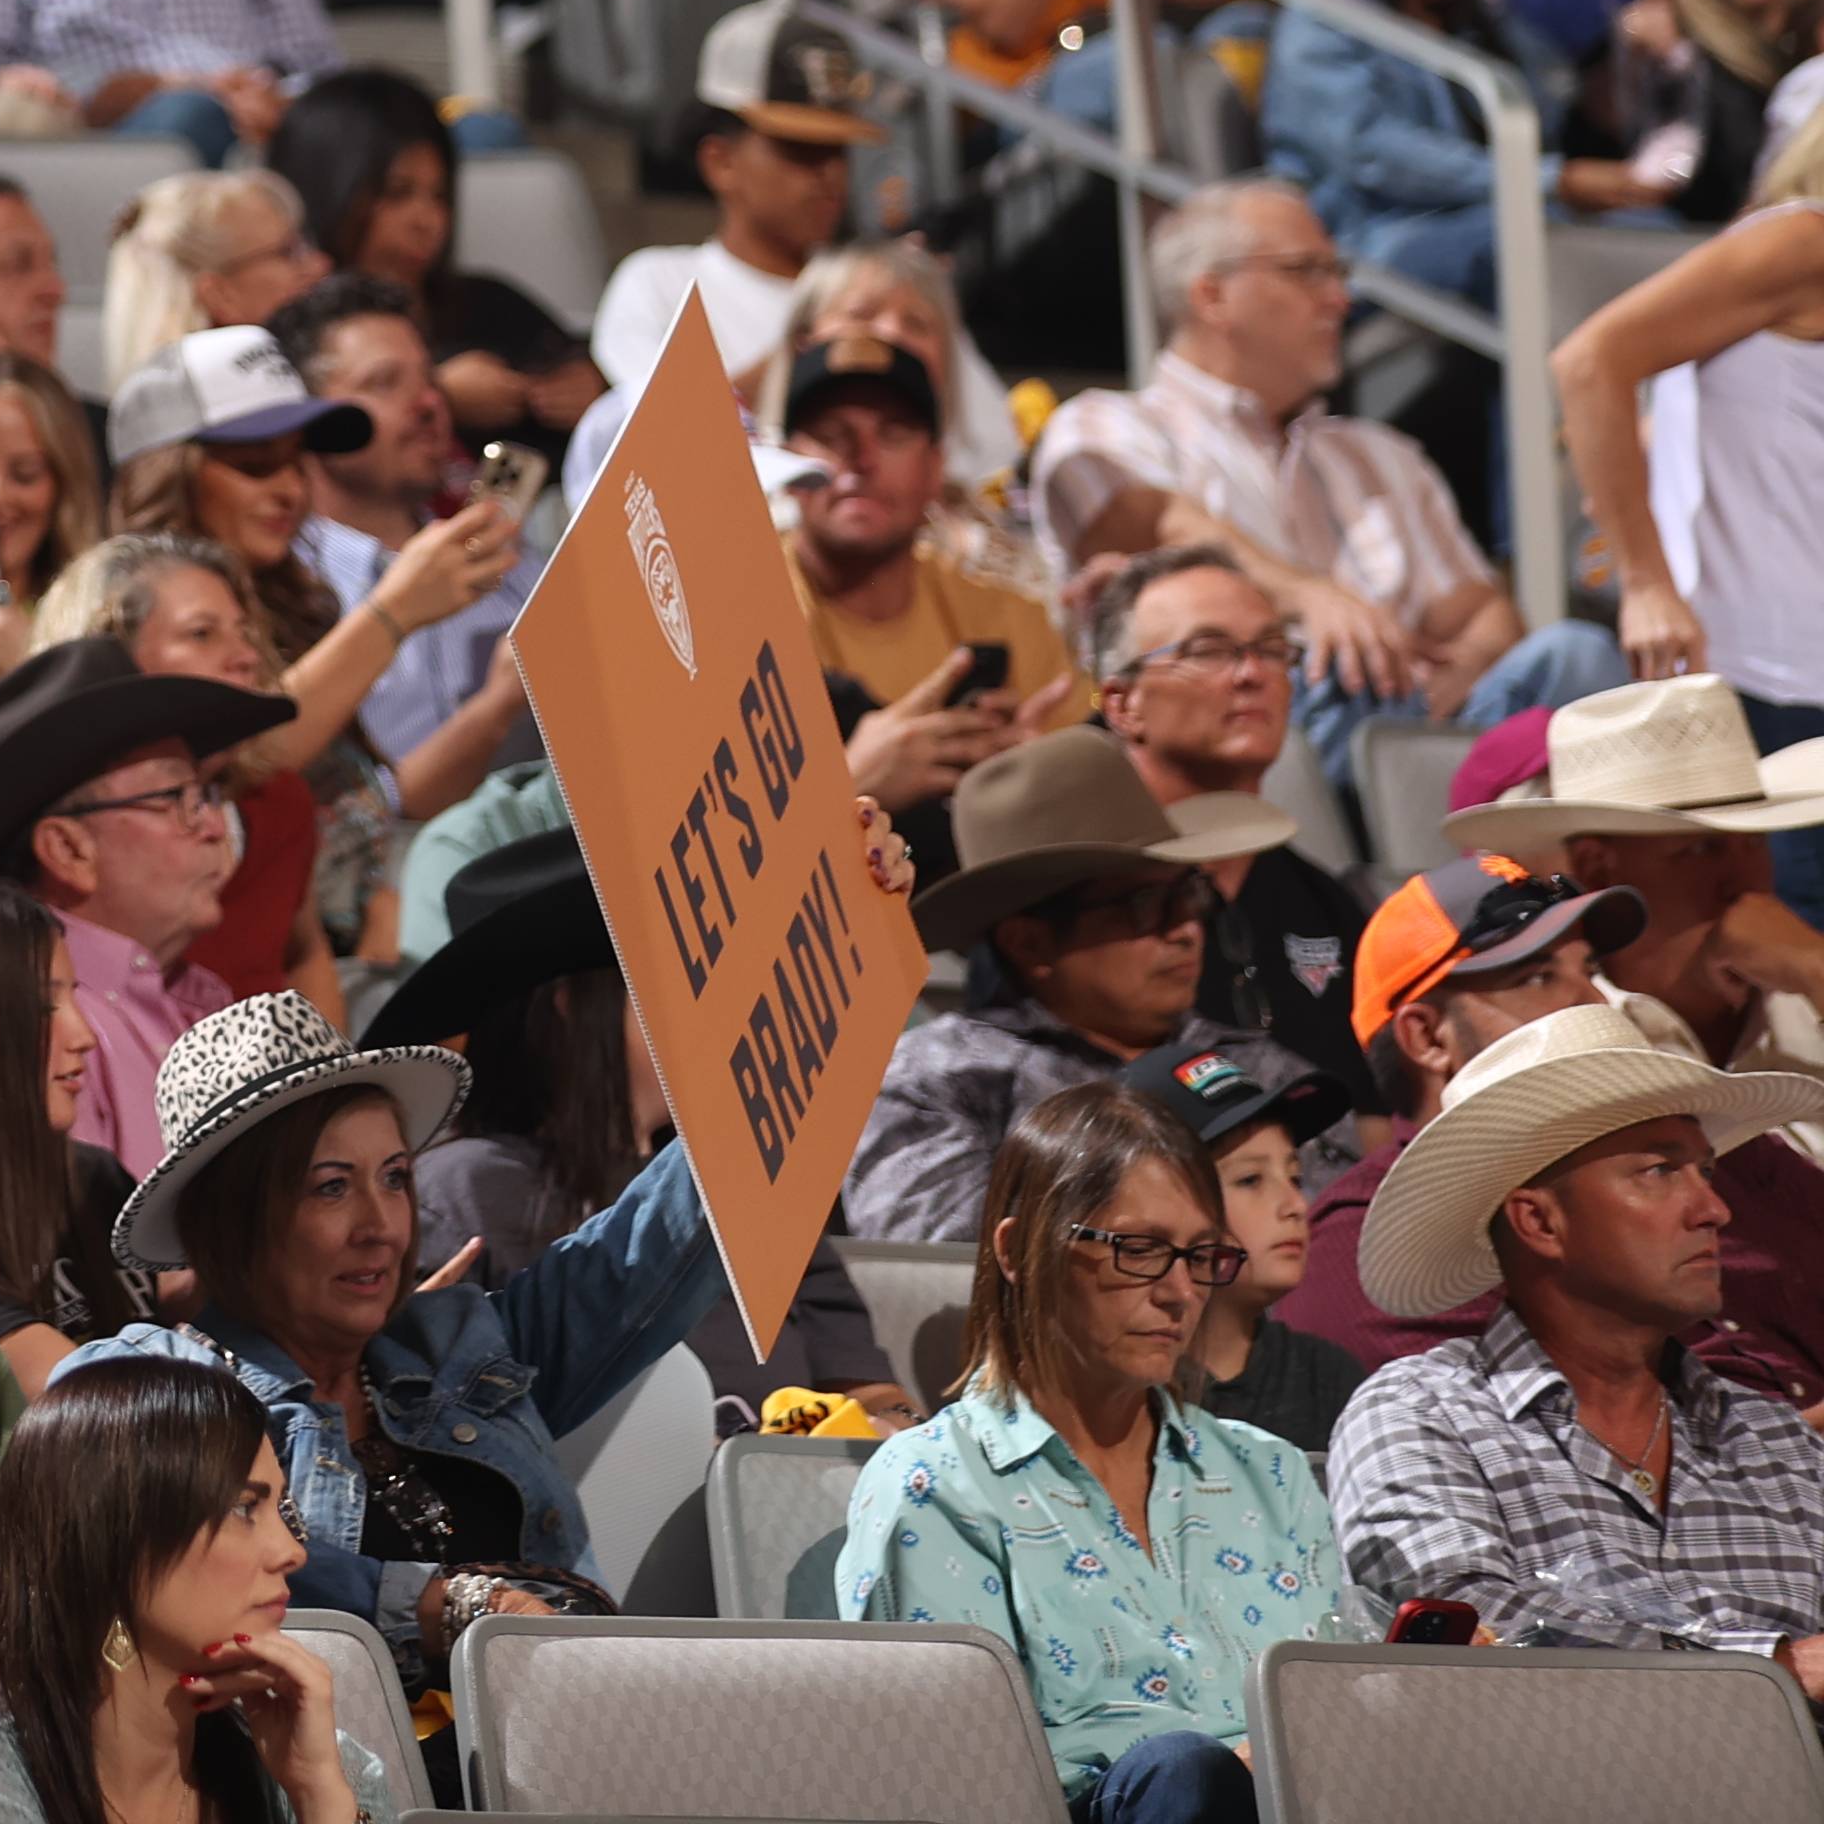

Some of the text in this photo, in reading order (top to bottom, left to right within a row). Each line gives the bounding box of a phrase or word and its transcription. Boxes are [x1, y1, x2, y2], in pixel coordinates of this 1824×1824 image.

[653, 638, 807, 1001] LET'S GO
[728, 846, 865, 1186] BRADY!
